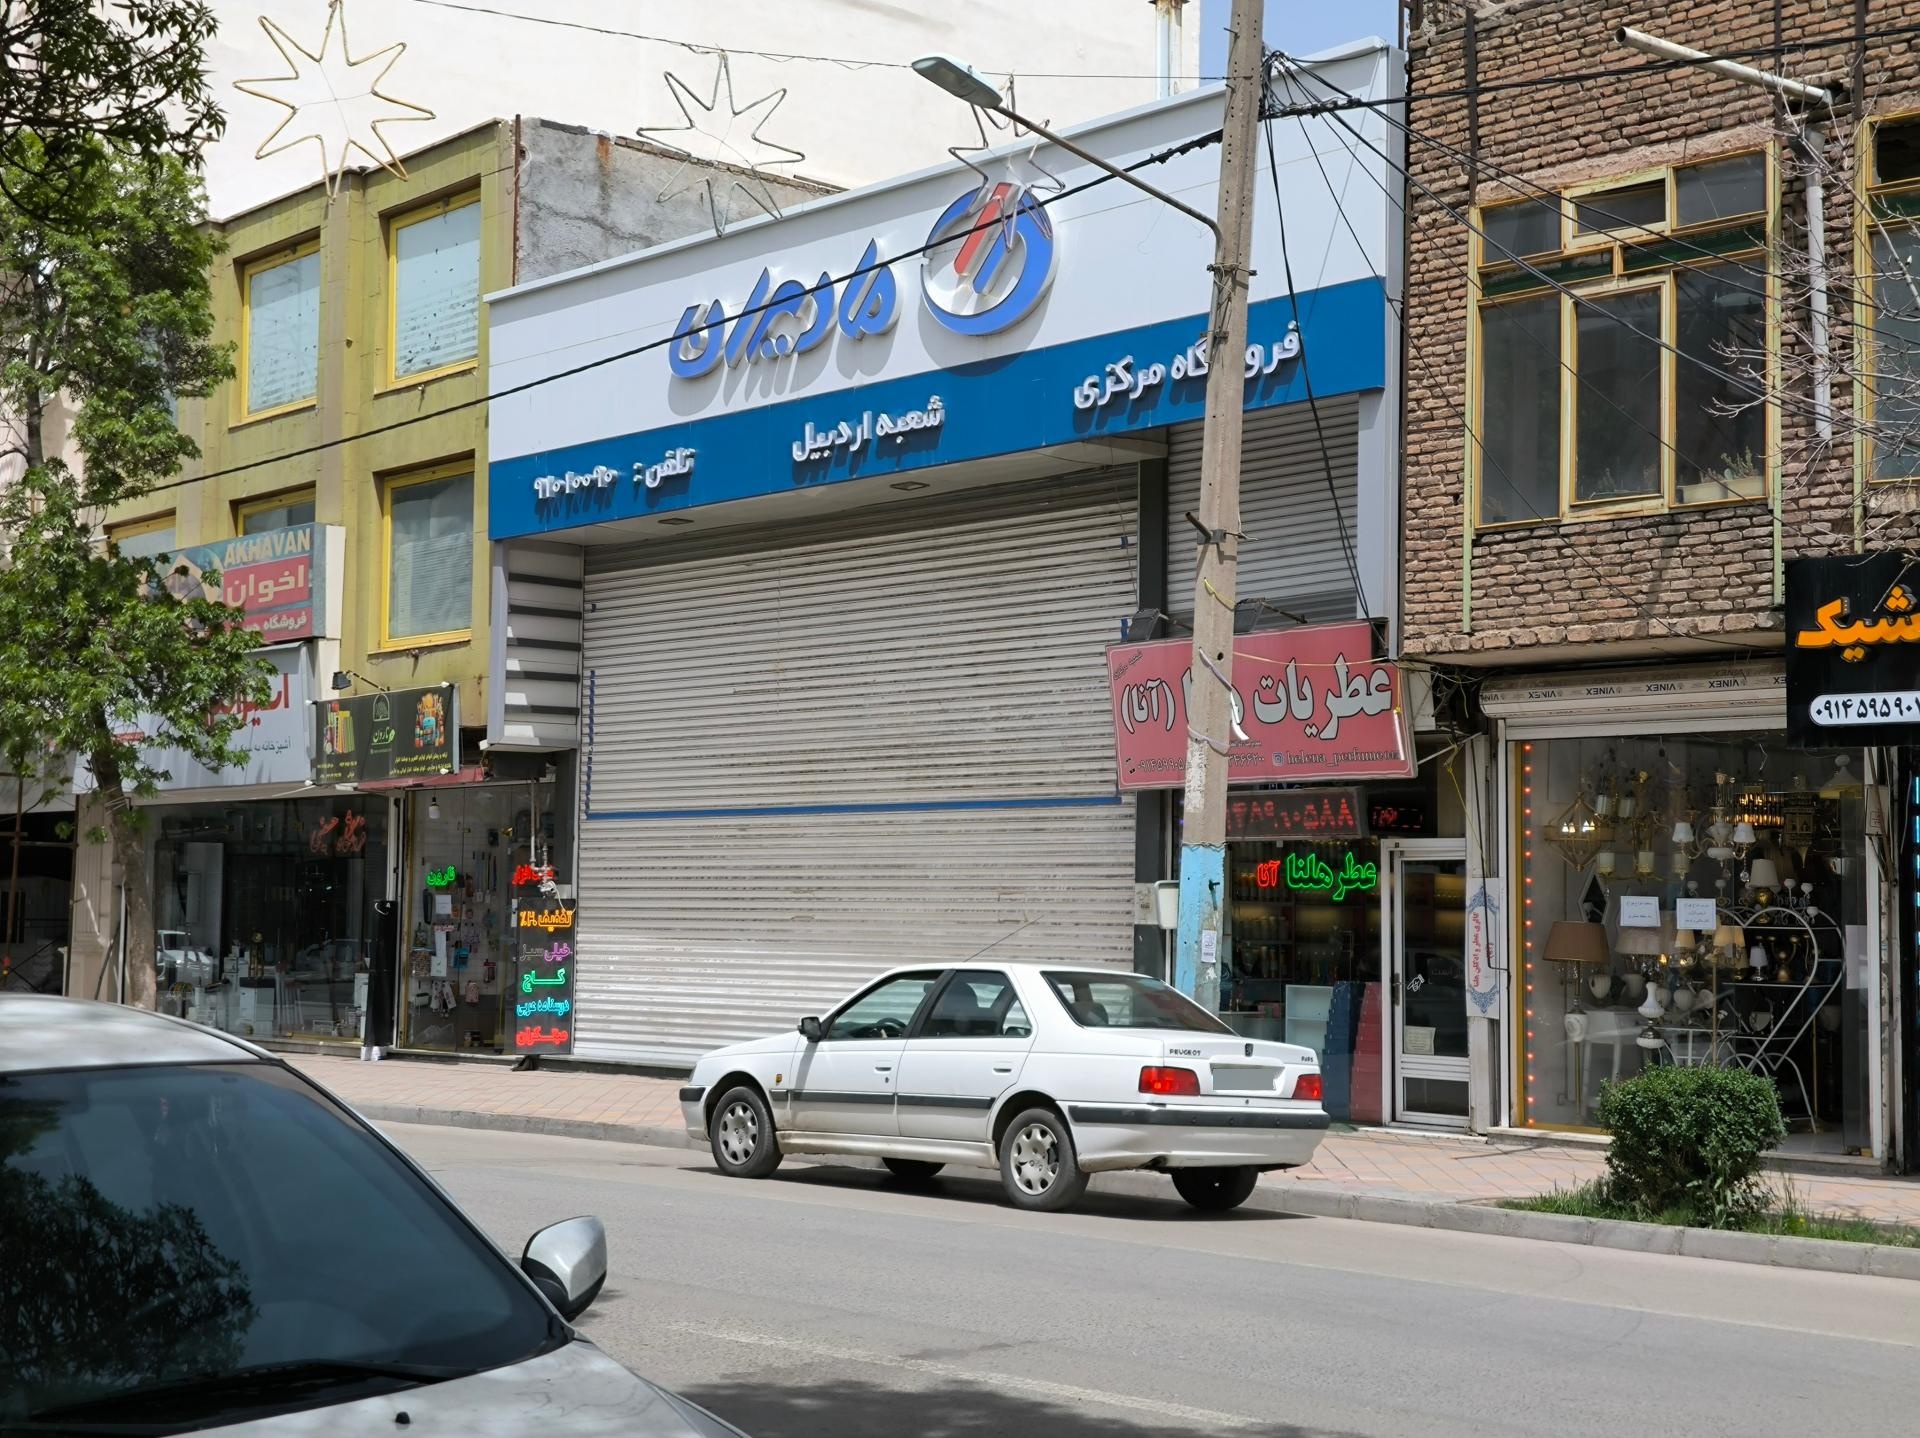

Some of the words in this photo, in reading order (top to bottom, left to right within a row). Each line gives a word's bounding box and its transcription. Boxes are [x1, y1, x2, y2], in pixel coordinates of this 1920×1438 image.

[1171, 320, 1301, 380] فروگاه
[1074, 354, 1166, 409] مرکزی
[875, 394, 945, 444] شعبه
[792, 410, 873, 462] اردبیل
[224, 528, 311, 567] AKHAVAN
[226, 564, 305, 608] اخوان
[263, 611, 307, 633] فروشگاه
[1253, 652, 1393, 741] عطریات
[1585, 686, 1615, 697] VINEX
[1645, 682, 1676, 693] VINEX
[1708, 678, 1740, 689] VINEX
[1257, 860, 1281, 887] آنا
[1286, 852, 1335, 889] هلنا
[1332, 851, 1377, 900] عطر
[538, 908, 572, 932] تخفیف
[544, 942, 572, 961] خیلی
[522, 968, 566, 993] گاج
[1169, 1048, 1201, 1057] PEUGEOT
